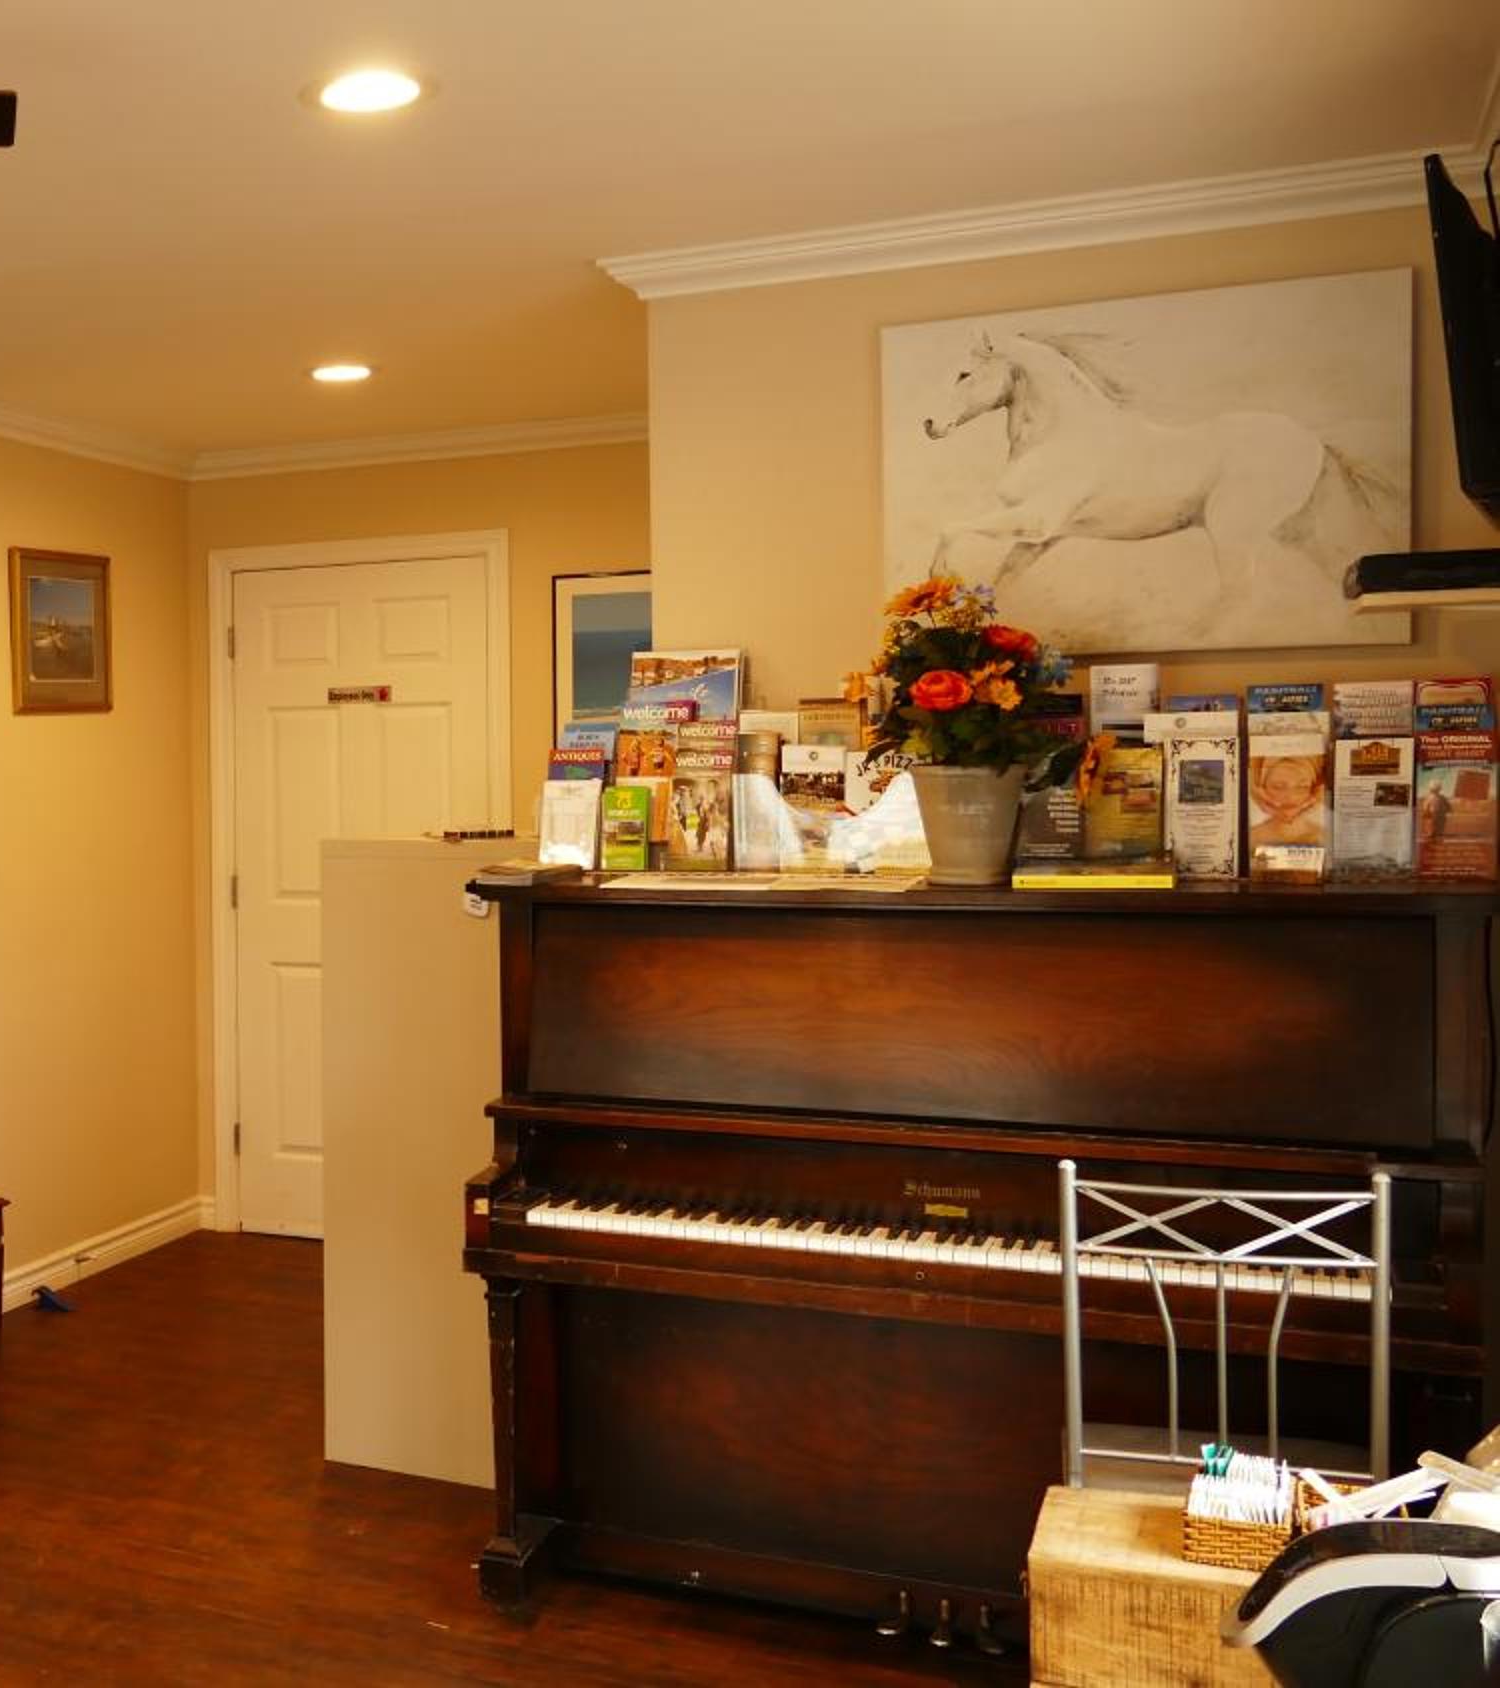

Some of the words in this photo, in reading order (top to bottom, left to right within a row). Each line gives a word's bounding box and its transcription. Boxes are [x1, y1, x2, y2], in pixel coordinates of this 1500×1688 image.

[623, 705, 689, 721] welcome
[680, 724, 737, 738] welcome
[1441, 734, 1492, 744] ORIGINAL
[676, 752, 733, 767] welcome
[883, 754, 913, 771] PIZZ
